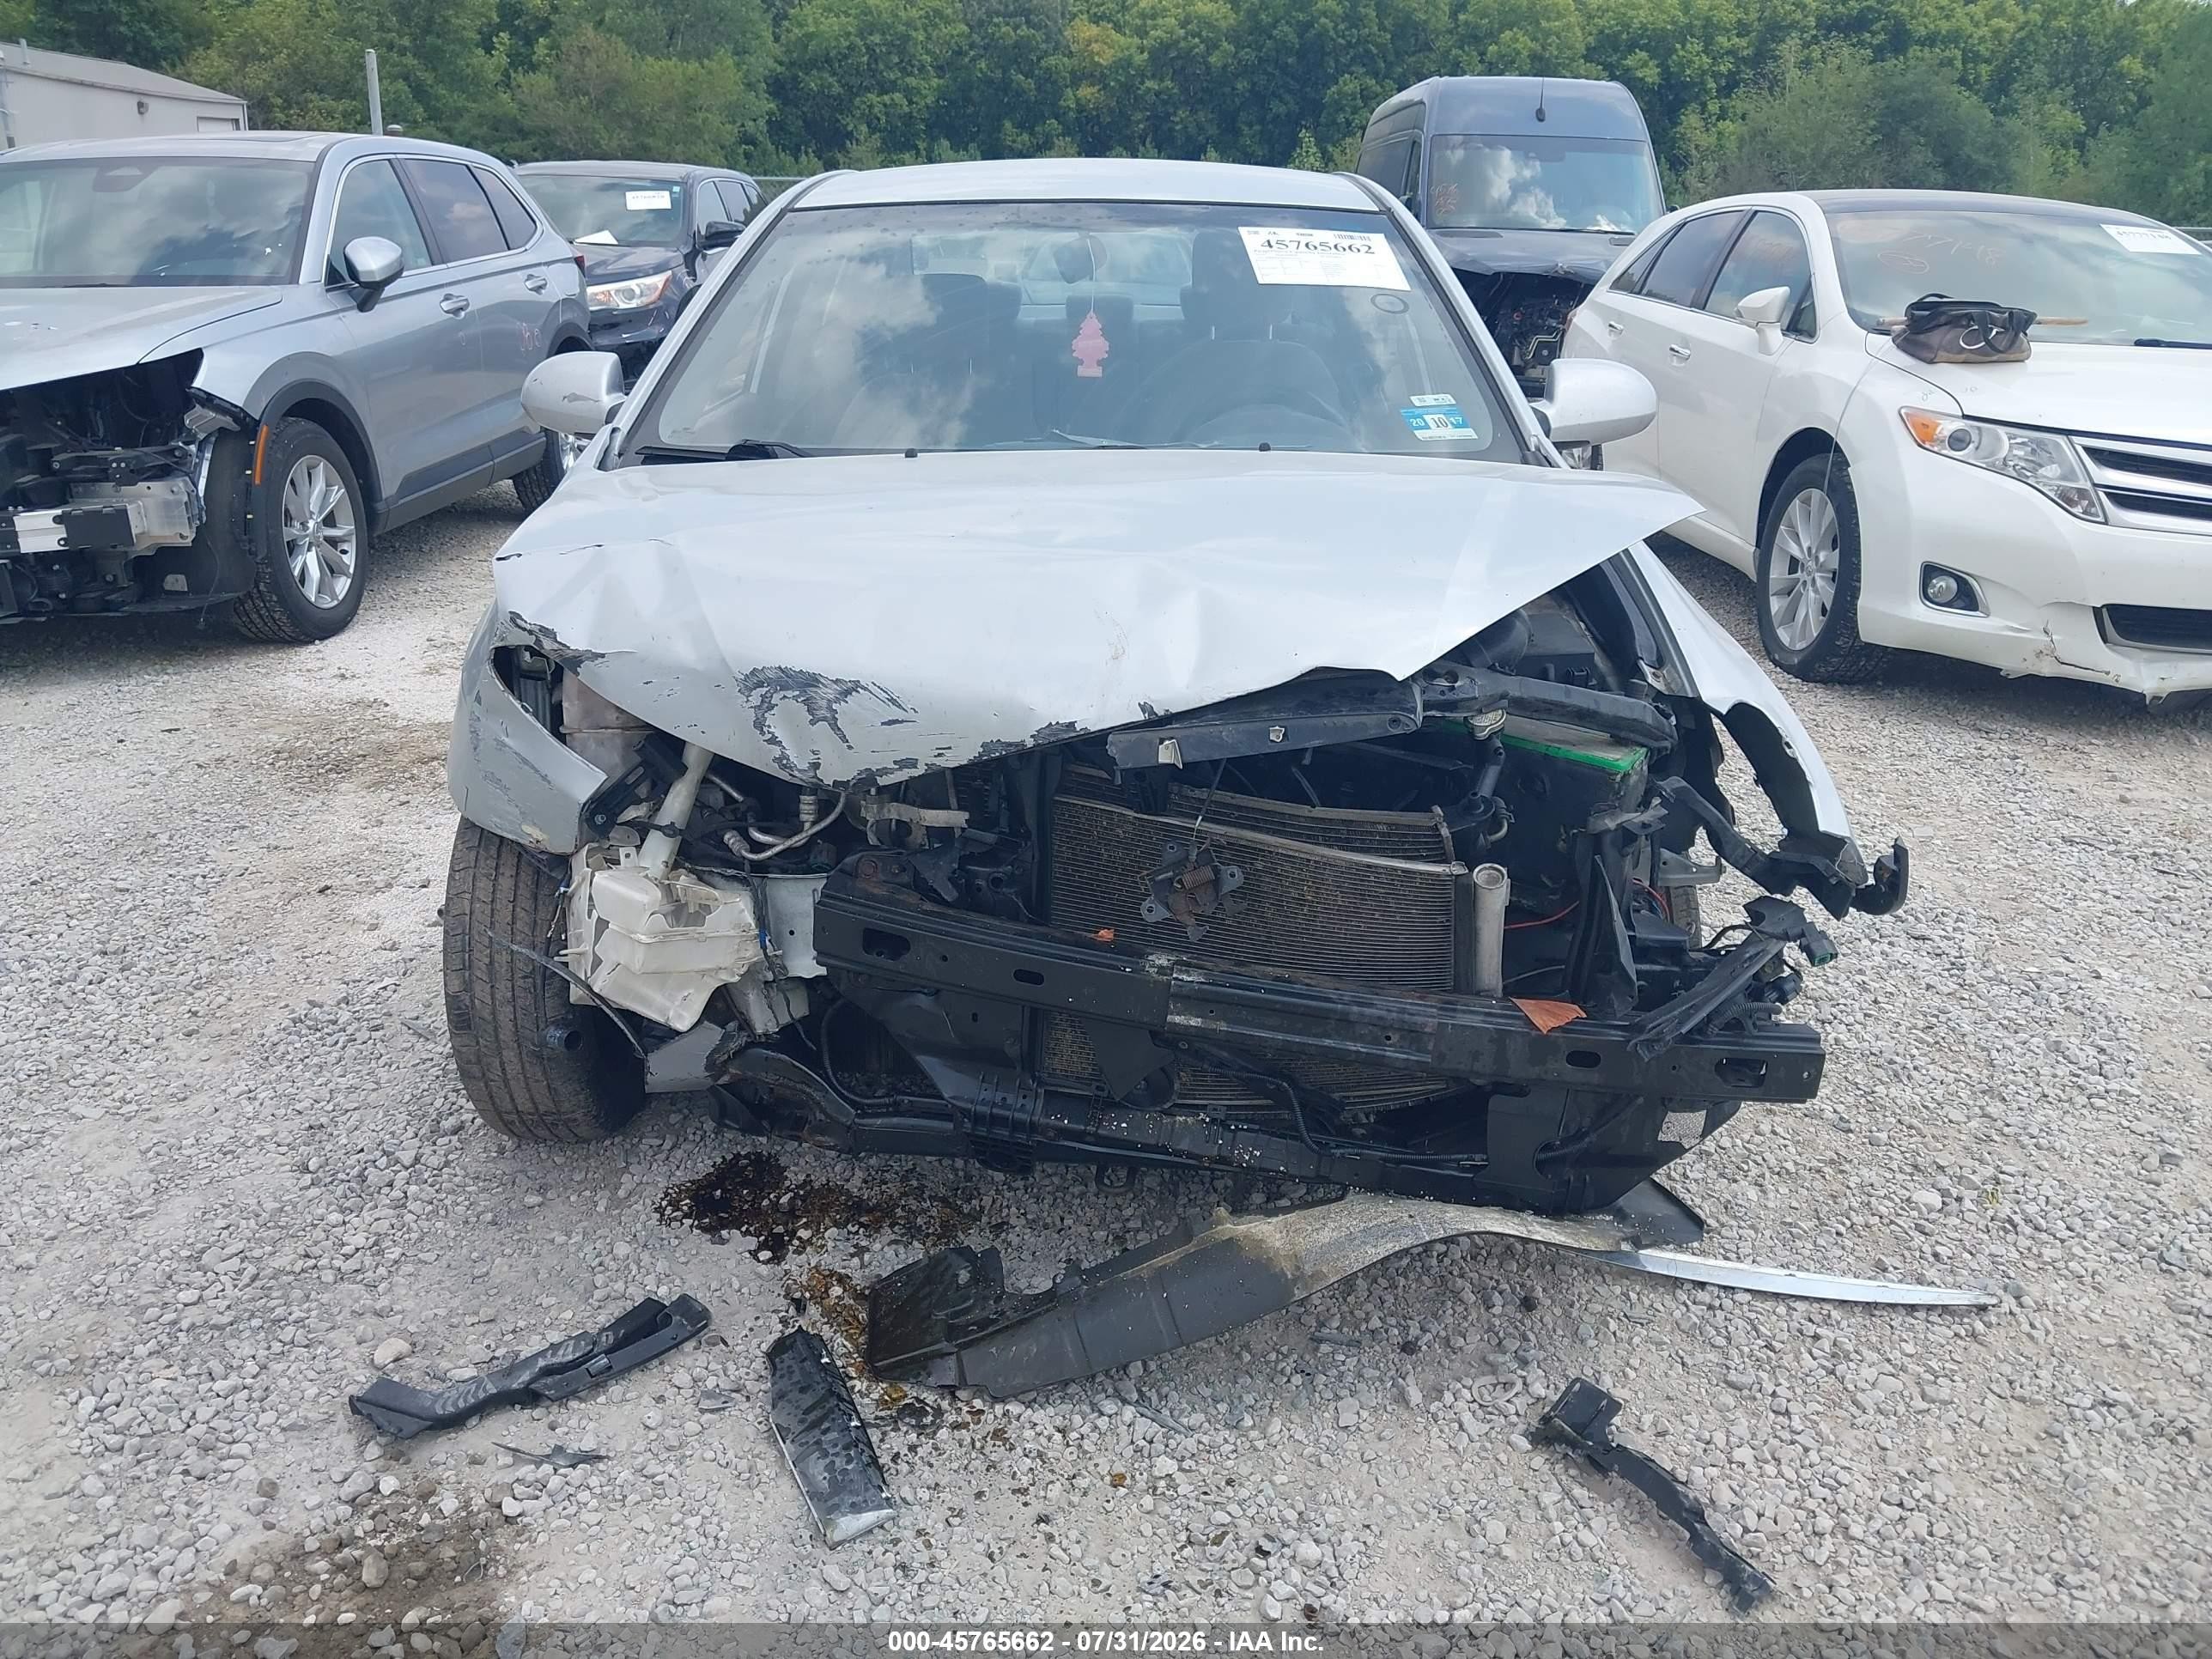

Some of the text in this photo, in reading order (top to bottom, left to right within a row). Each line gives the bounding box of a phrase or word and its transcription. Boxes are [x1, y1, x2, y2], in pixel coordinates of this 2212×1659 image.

[1260, 238, 1376, 255] 45765662
[1409, 416, 1464, 428] 20 10 17
